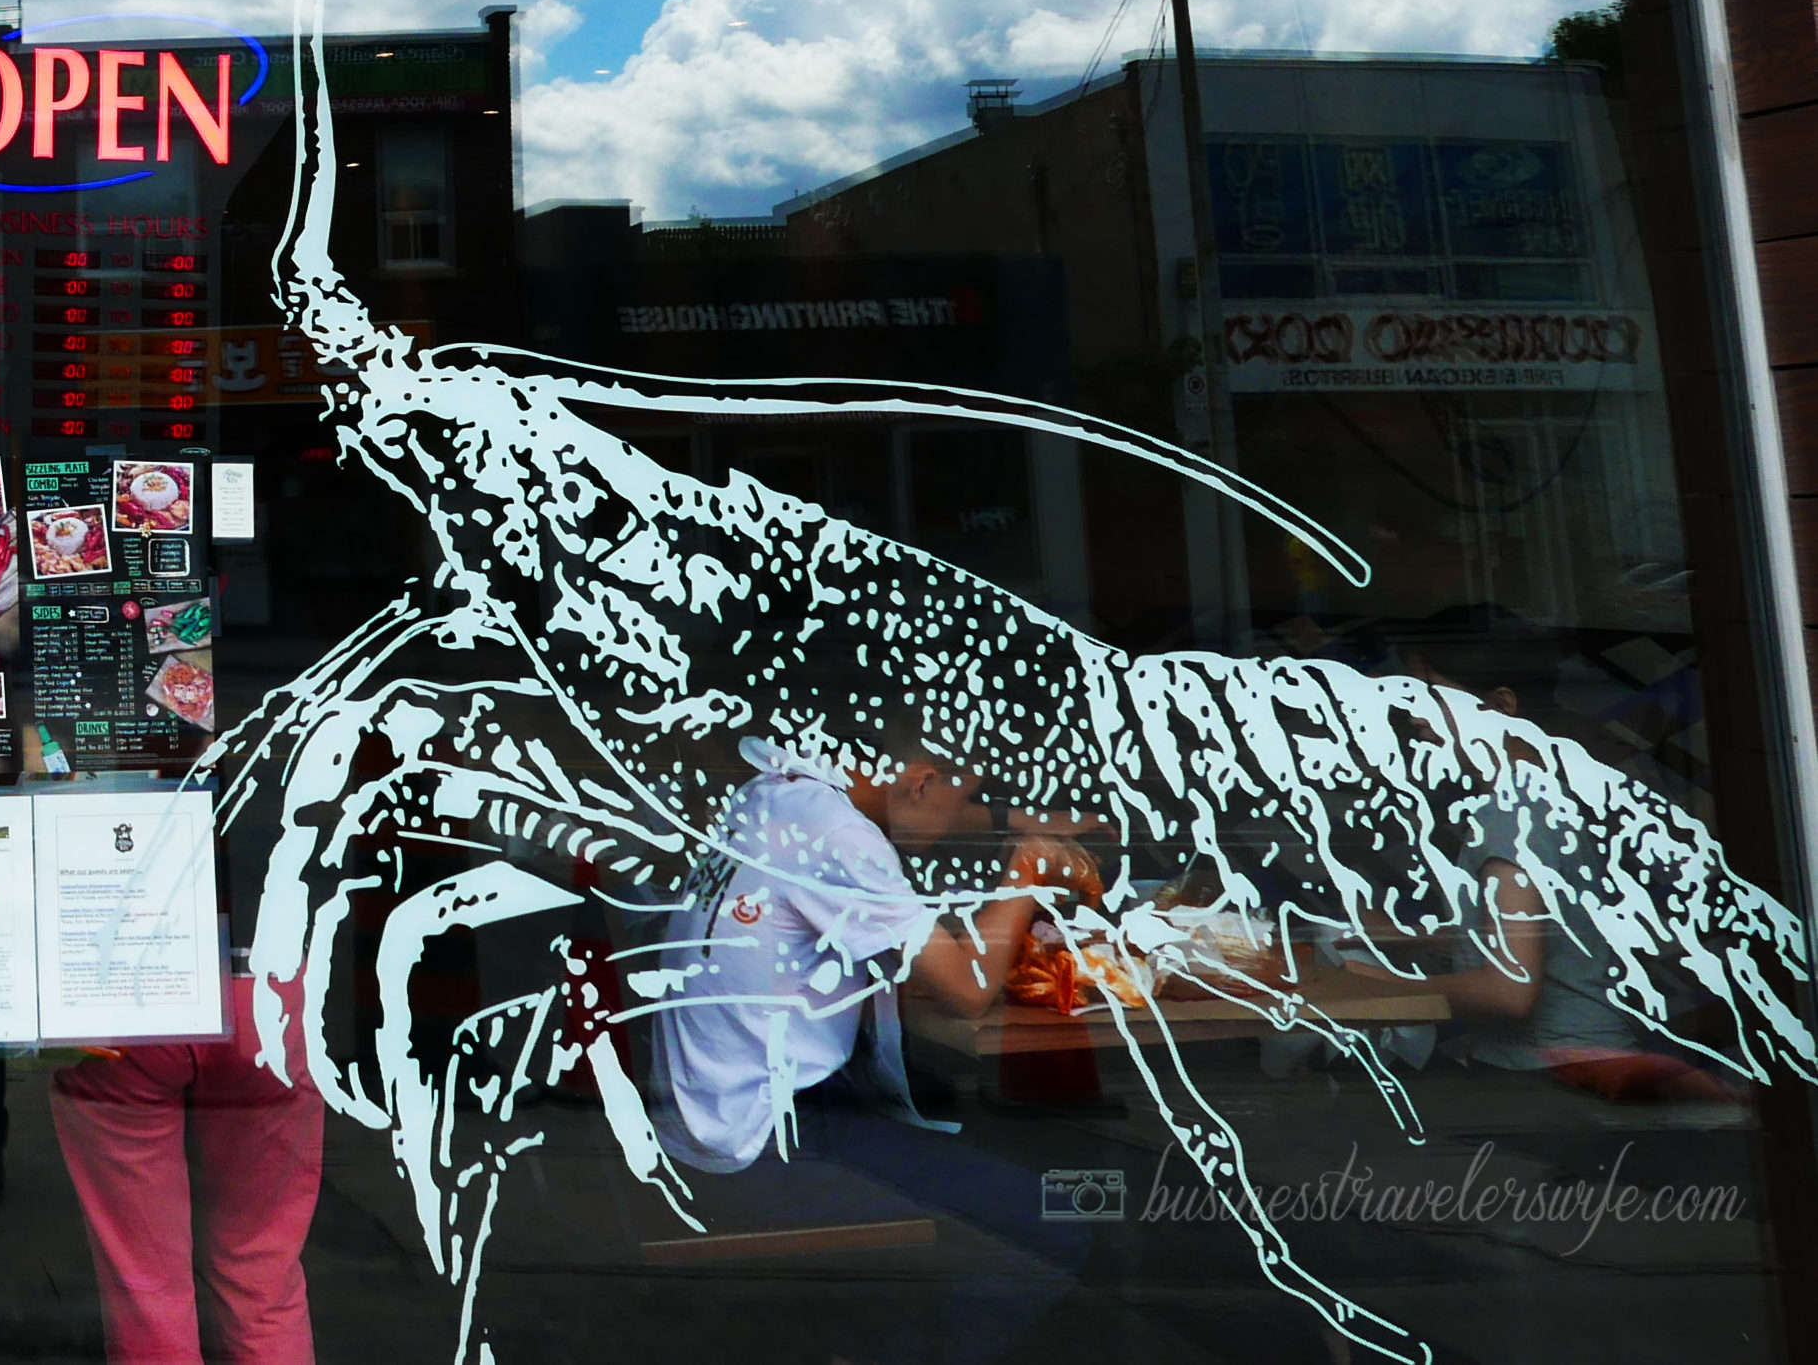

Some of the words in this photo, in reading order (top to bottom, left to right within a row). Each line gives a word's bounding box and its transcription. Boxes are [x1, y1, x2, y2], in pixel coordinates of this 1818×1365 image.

[108, 214, 209, 240] HOURS
[65, 463, 89, 473] PLATE
[28, 479, 58, 490] COMBO
[33, 606, 61, 619] SIDES
[77, 722, 108, 734] DRINKS
